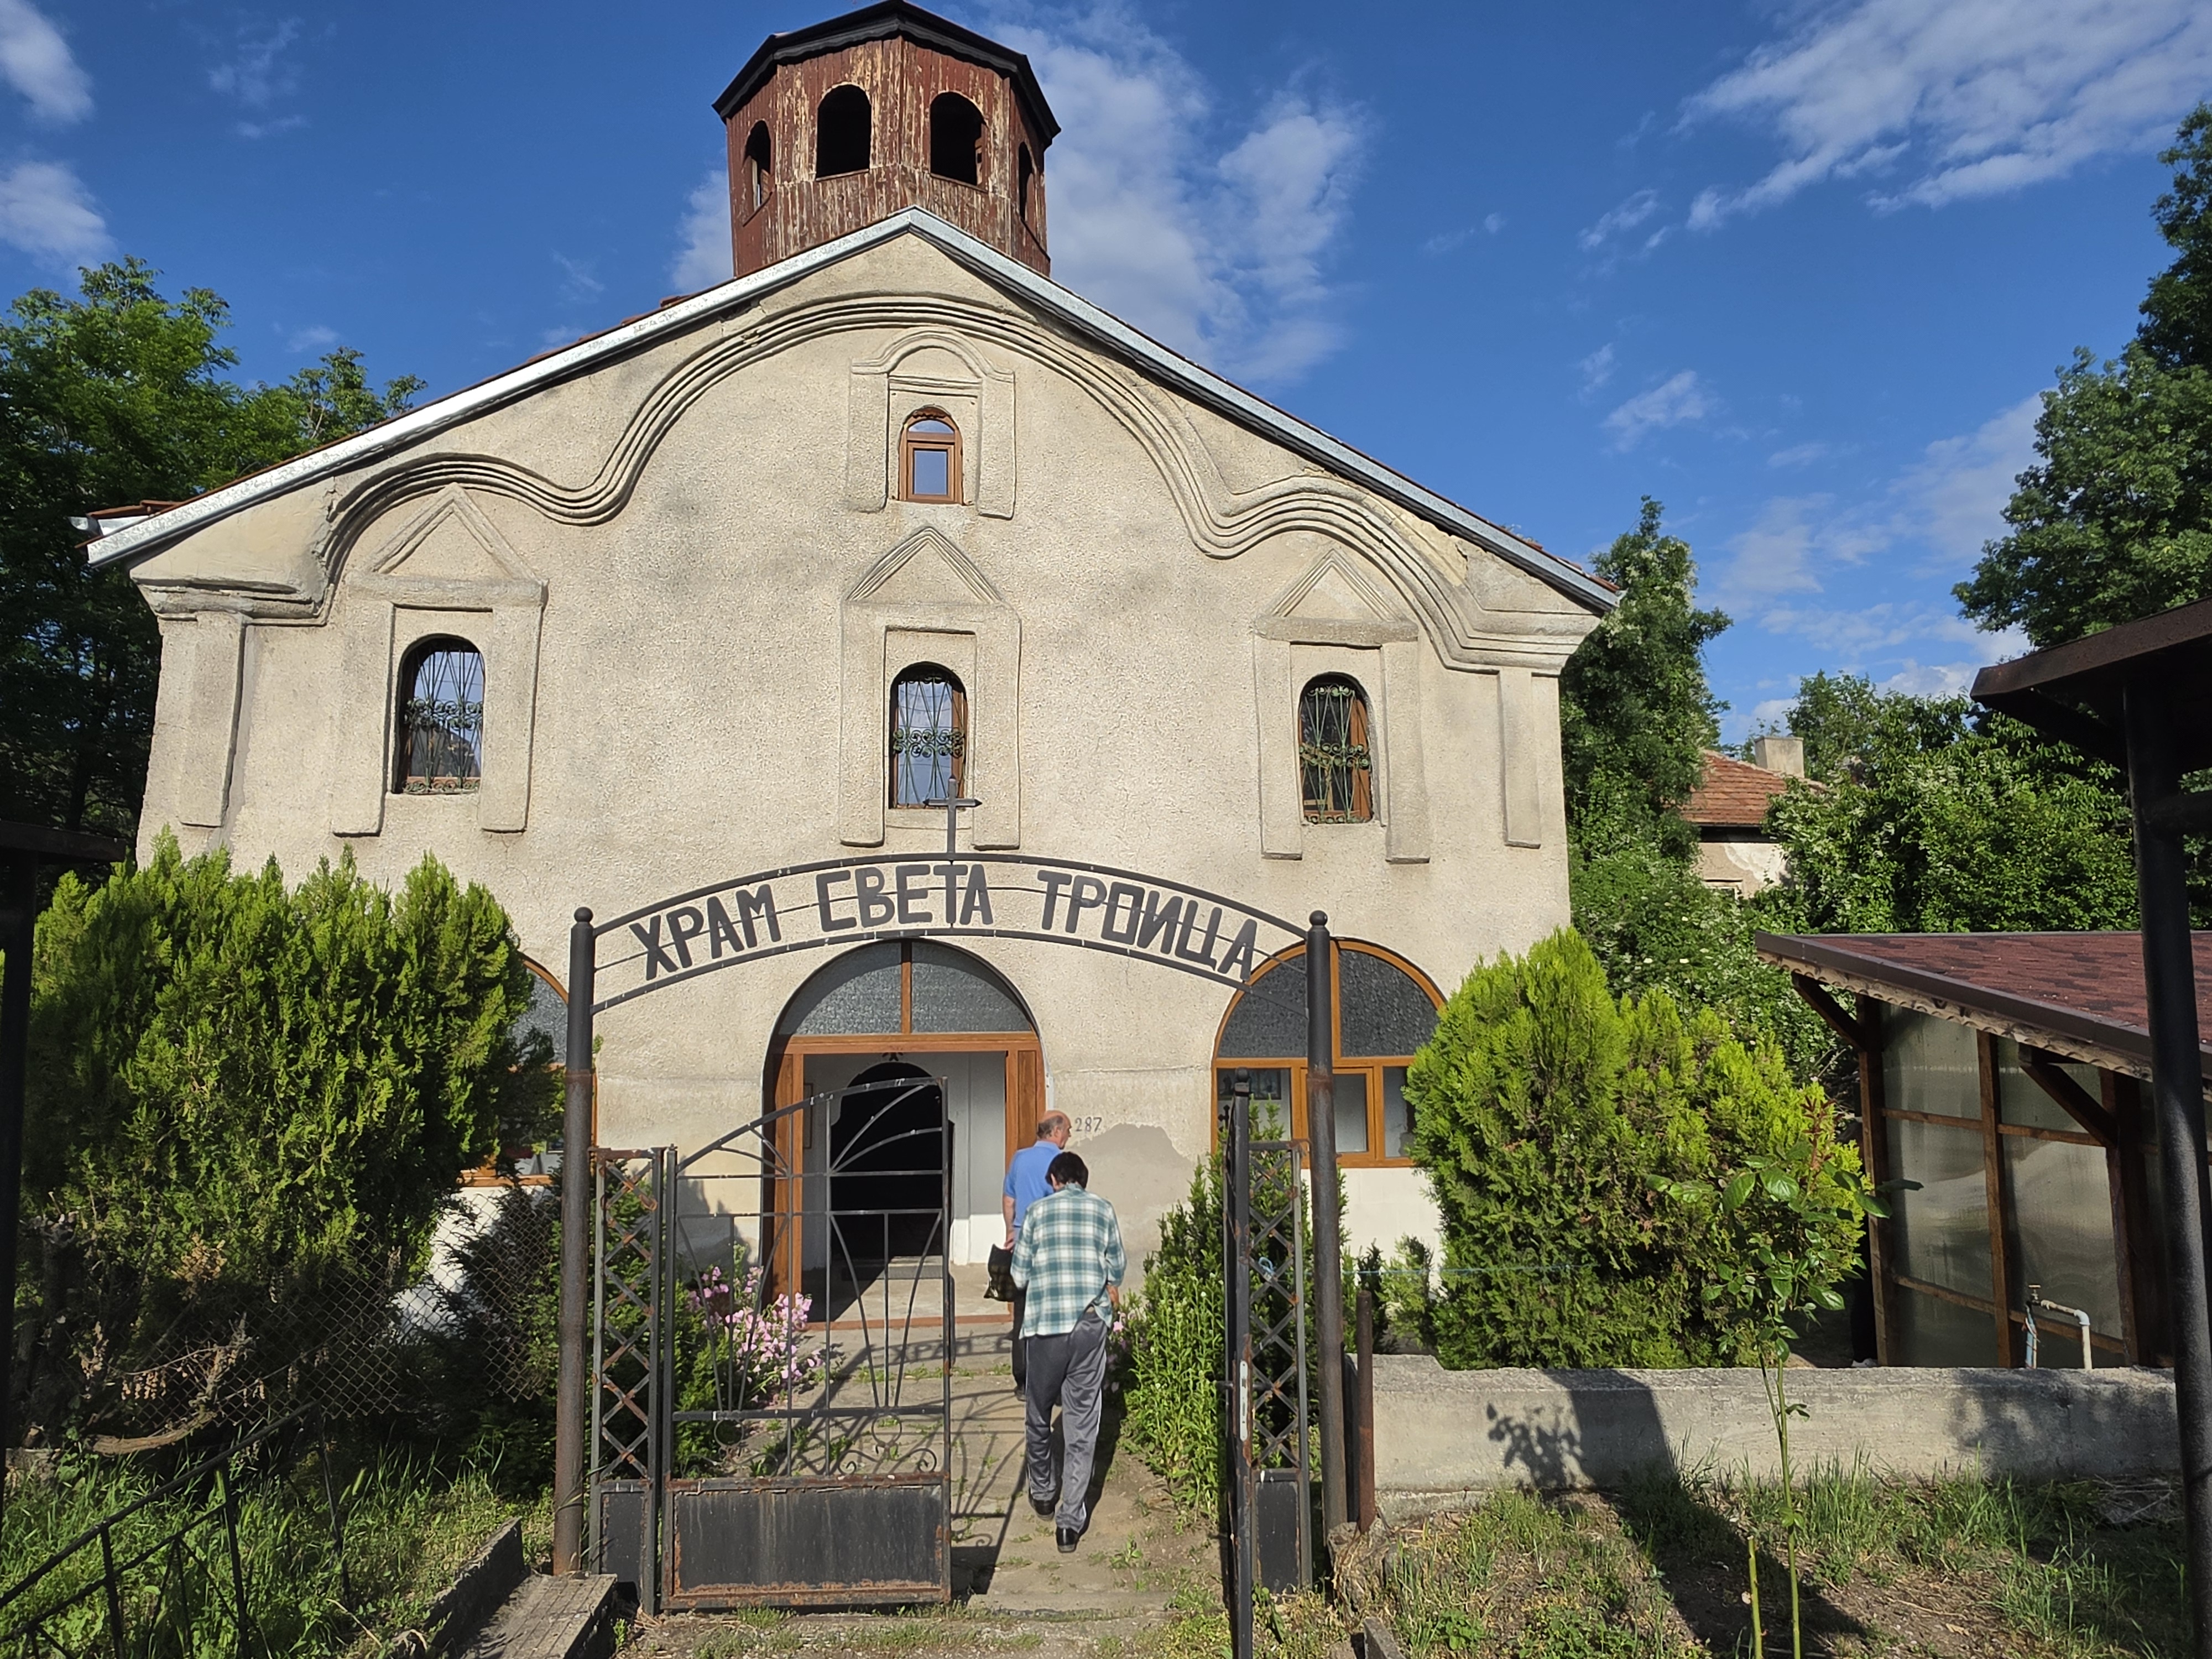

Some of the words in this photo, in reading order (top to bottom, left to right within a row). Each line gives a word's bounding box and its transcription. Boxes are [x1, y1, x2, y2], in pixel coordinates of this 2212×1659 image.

[629, 884, 781, 980] ХРАМ
[816, 864, 993, 932] СВЕТА
[1037, 870, 1258, 981] ТРОИЦА
[1075, 1117, 1102, 1132] 287
